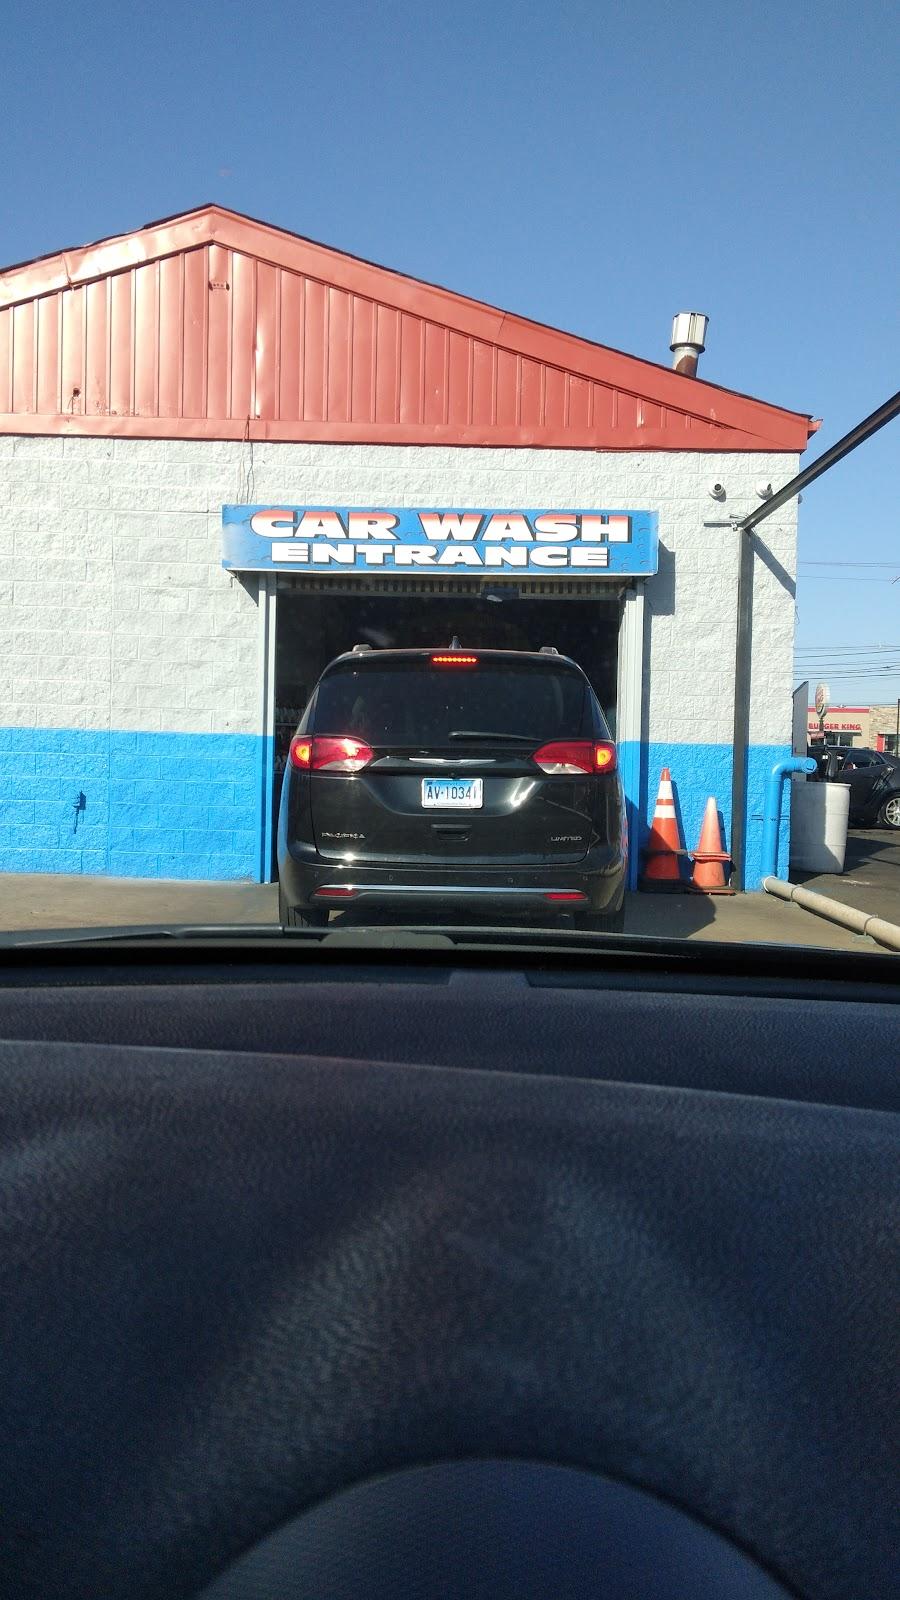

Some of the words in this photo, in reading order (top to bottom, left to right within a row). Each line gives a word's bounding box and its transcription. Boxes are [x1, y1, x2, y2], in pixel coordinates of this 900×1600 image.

[250, 509, 400, 540] CAR
[418, 512, 632, 543] WASH
[271, 542, 609, 568] ENTRANCE
